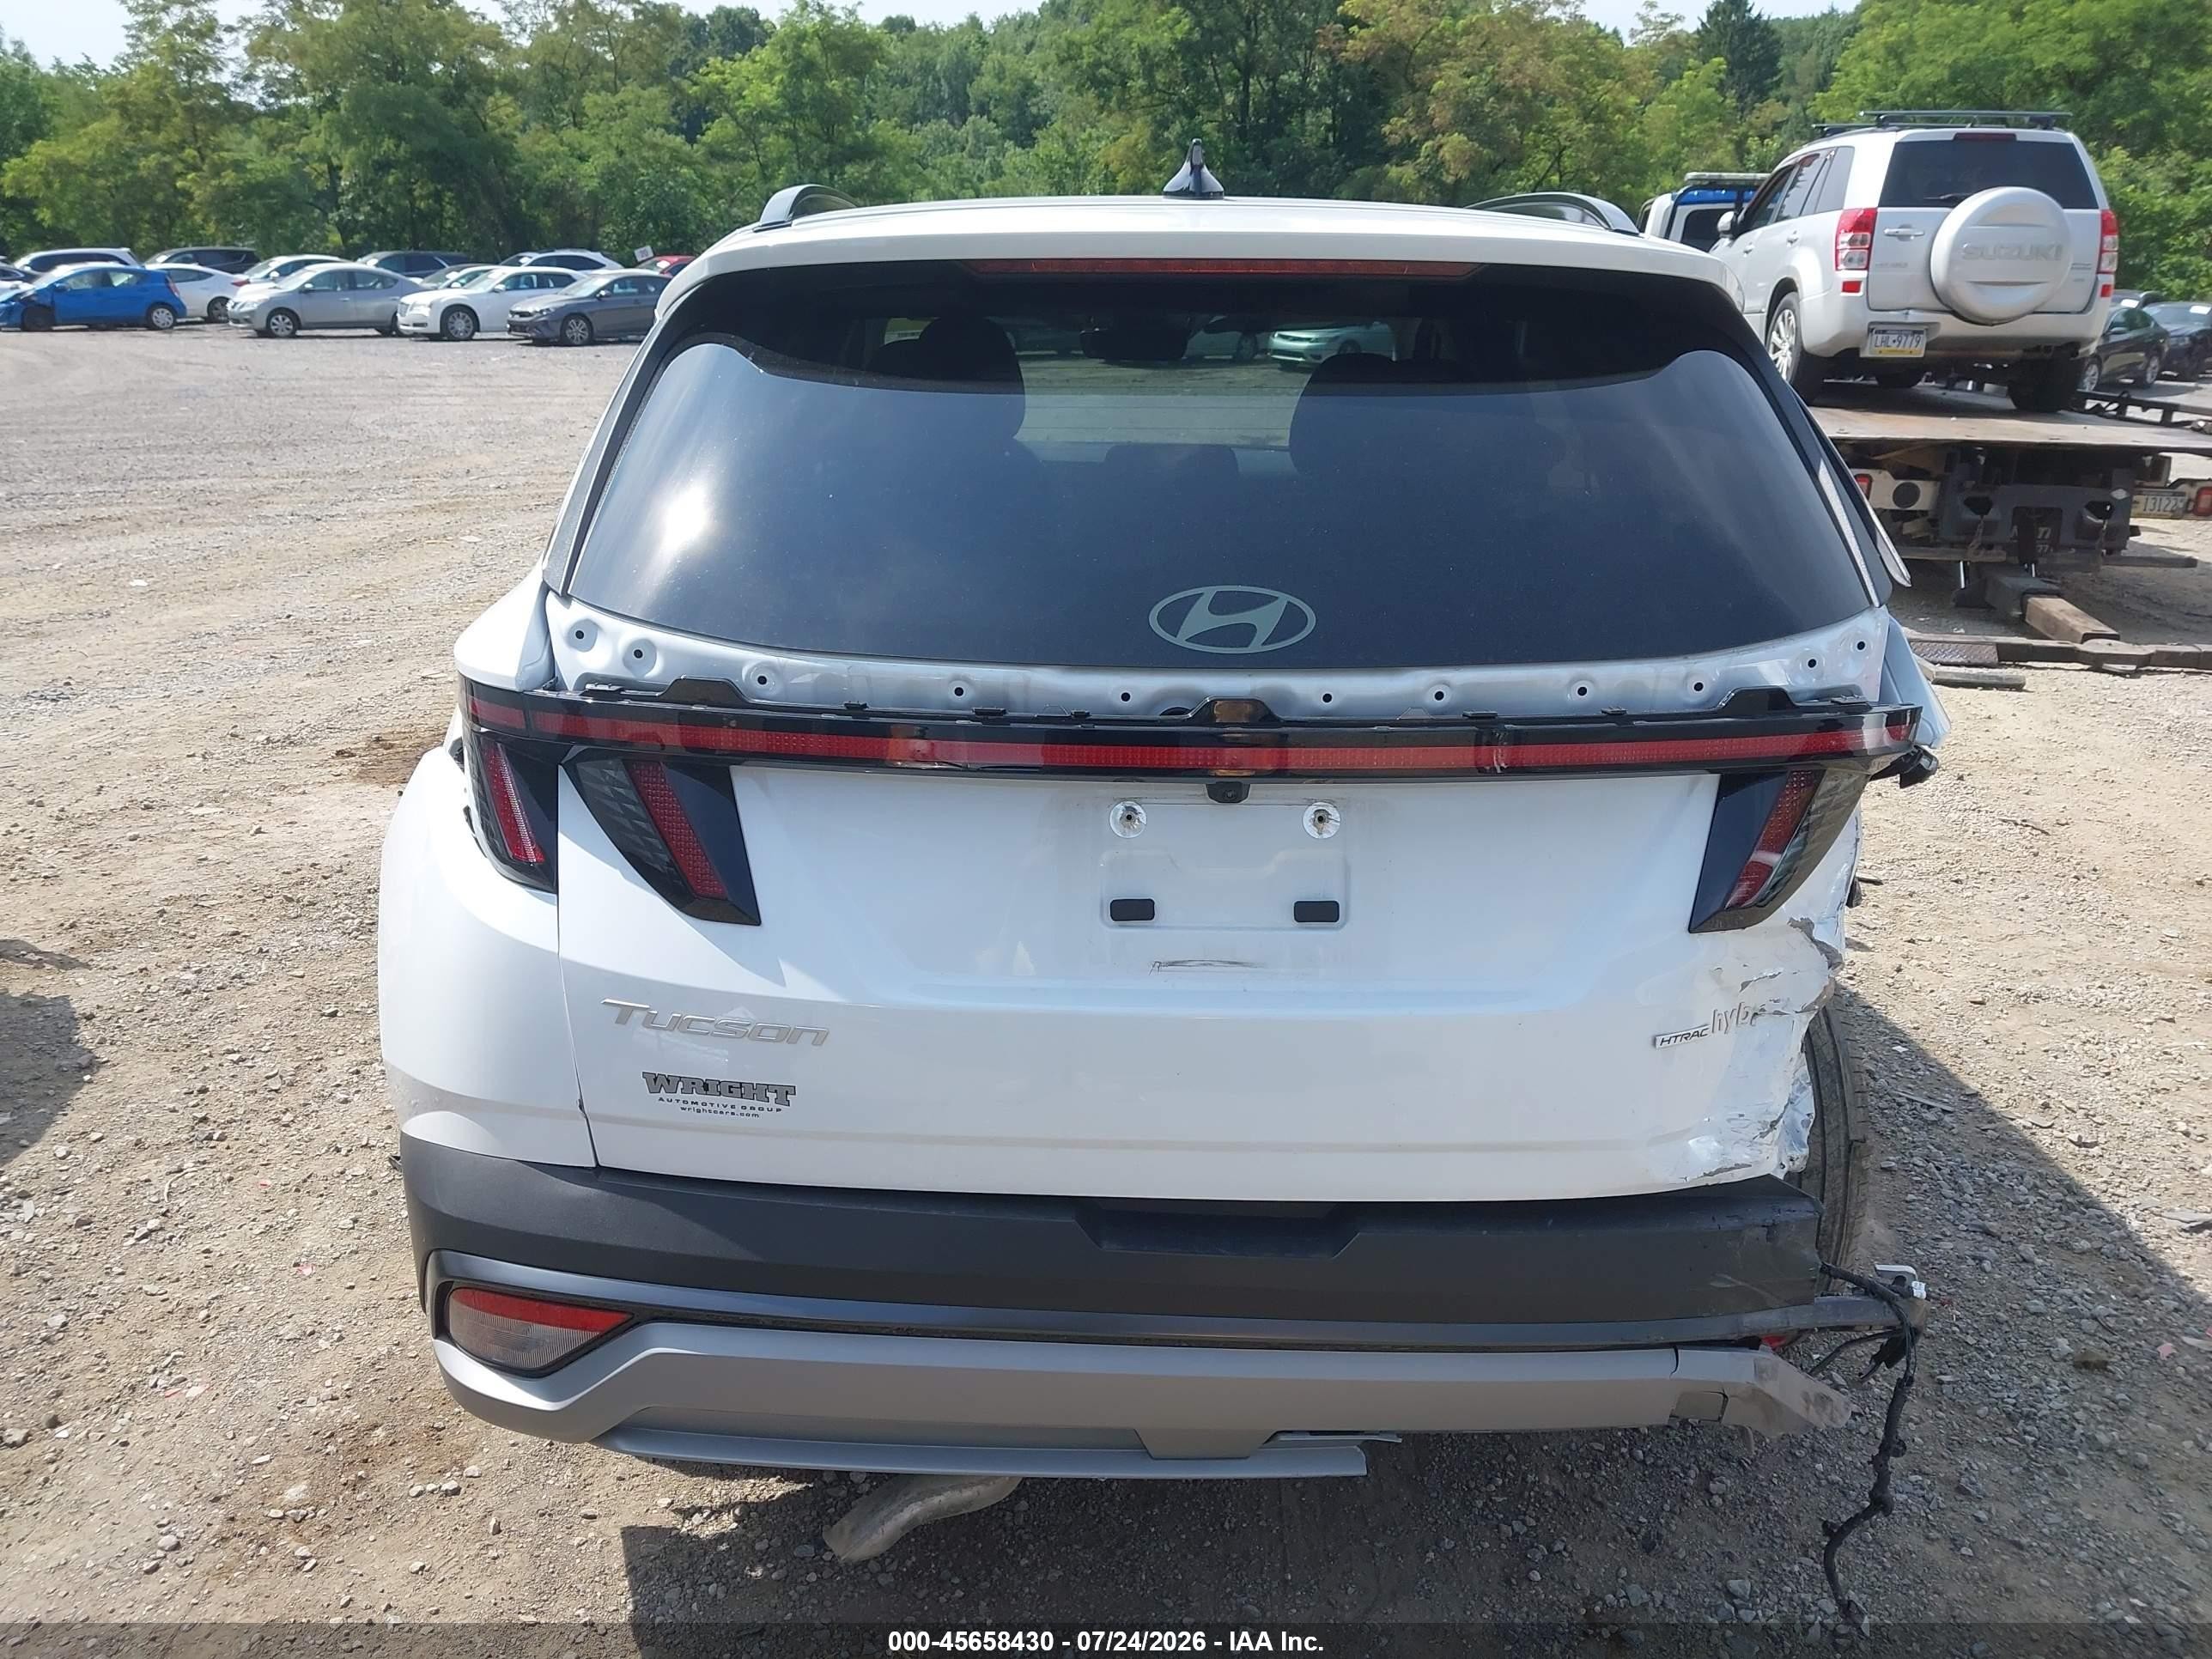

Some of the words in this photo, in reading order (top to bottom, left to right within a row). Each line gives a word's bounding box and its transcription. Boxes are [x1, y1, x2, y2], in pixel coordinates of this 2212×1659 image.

[1962, 242, 2063, 261] SUZUKI
[1659, 1027, 1711, 1047] HTRAC
[641, 1071, 797, 1107] WRIGHT
[657, 1097, 737, 1109] AUTOMOTIVE
[740, 1104, 782, 1113] GROUP
[680, 1105, 760, 1119] wrightcars.com
